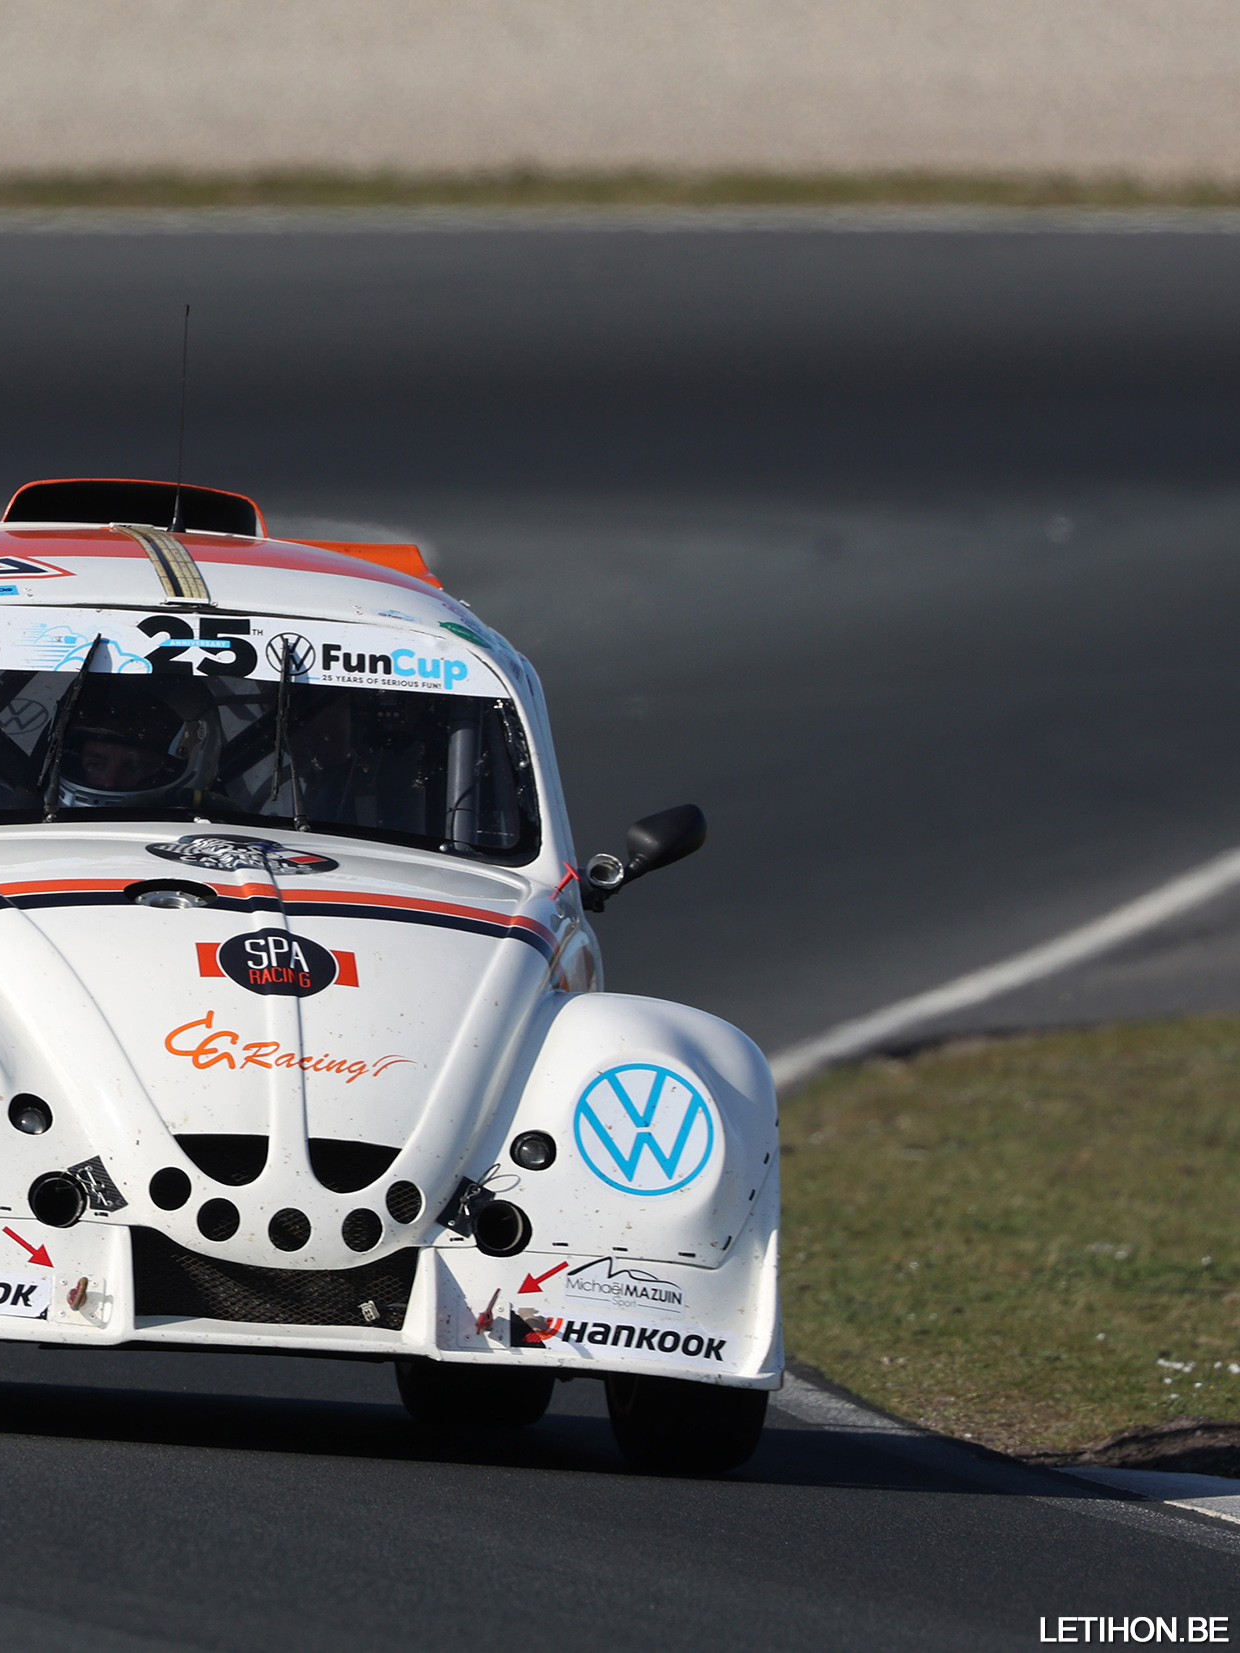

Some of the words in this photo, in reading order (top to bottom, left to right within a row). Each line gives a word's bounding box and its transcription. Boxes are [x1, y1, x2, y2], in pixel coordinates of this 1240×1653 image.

[136, 615, 258, 678] 25
[252, 629, 264, 637] TH
[169, 639, 228, 648] ANNIVERSARY
[322, 643, 468, 690] FunCup
[336, 675, 364, 685] YEARS
[382, 679, 419, 688] SERIOUS
[422, 682, 442, 690] FUN!
[244, 936, 310, 973] SPA
[248, 967, 311, 988] RACING
[240, 1041, 370, 1083] Racing
[612, 1298, 637, 1309] Sport
